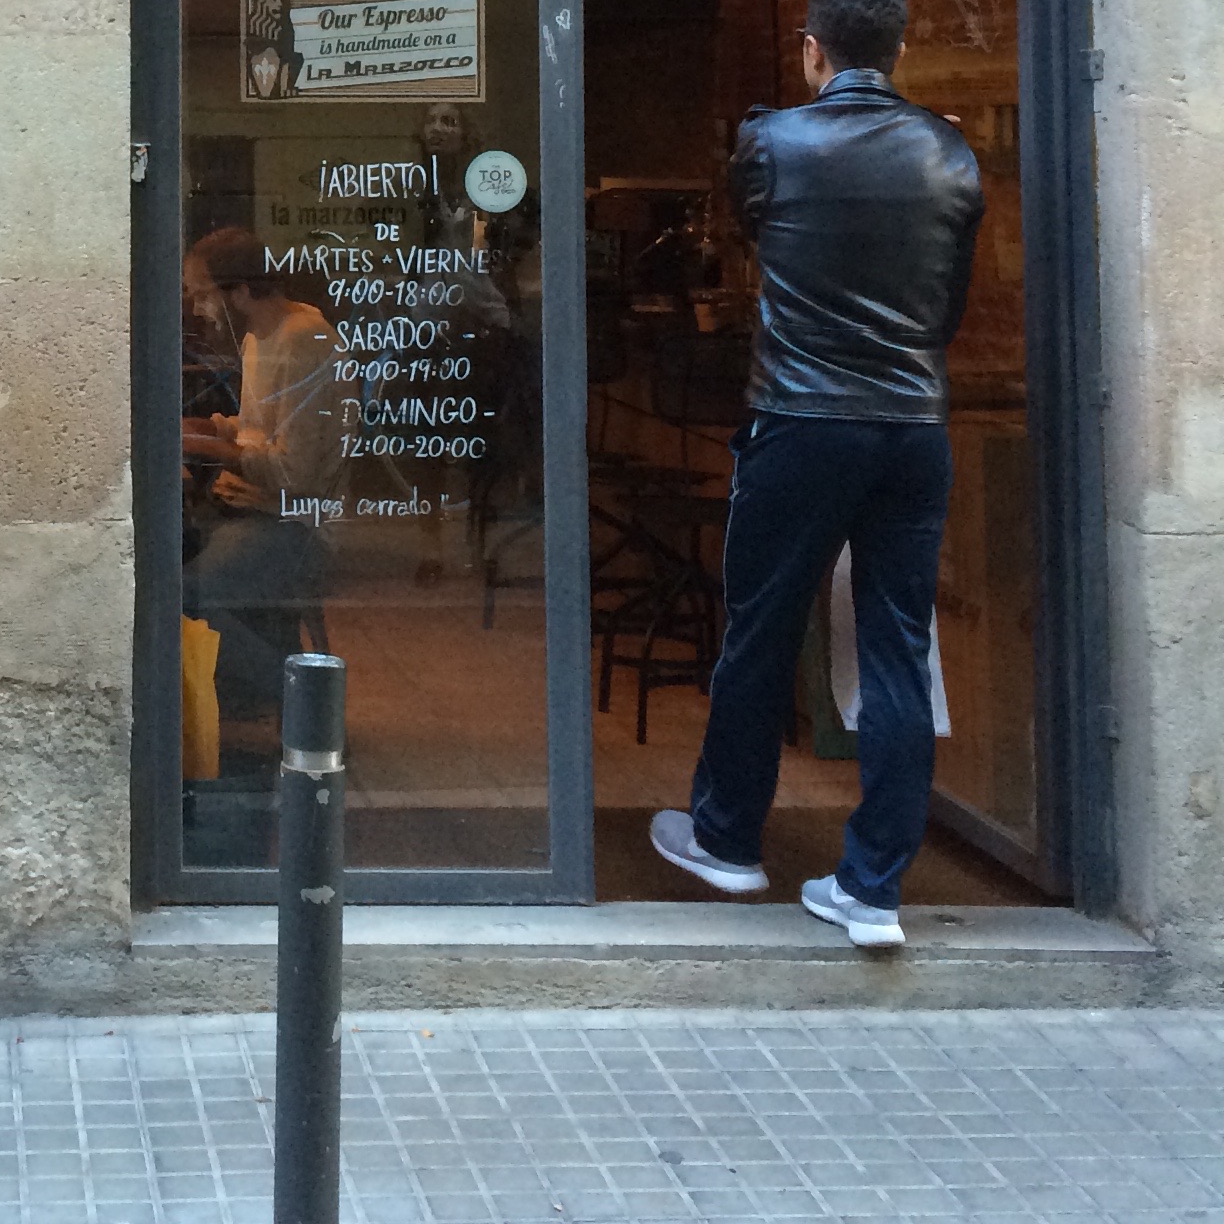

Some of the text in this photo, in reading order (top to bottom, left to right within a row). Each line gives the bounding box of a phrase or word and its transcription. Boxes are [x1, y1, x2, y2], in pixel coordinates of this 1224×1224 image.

[319, 6, 448, 32] Our Espresso
[319, 32, 457, 55] is handmade on a
[478, 169, 512, 181] TOP
[373, 222, 400, 242] DE
[328, 278, 466, 307] 9:00-18:00
[332, 357, 471, 382] 10:00-19:00
[341, 397, 476, 426] DOMINGO
[340, 434, 486, 459] 12:00-20:00
